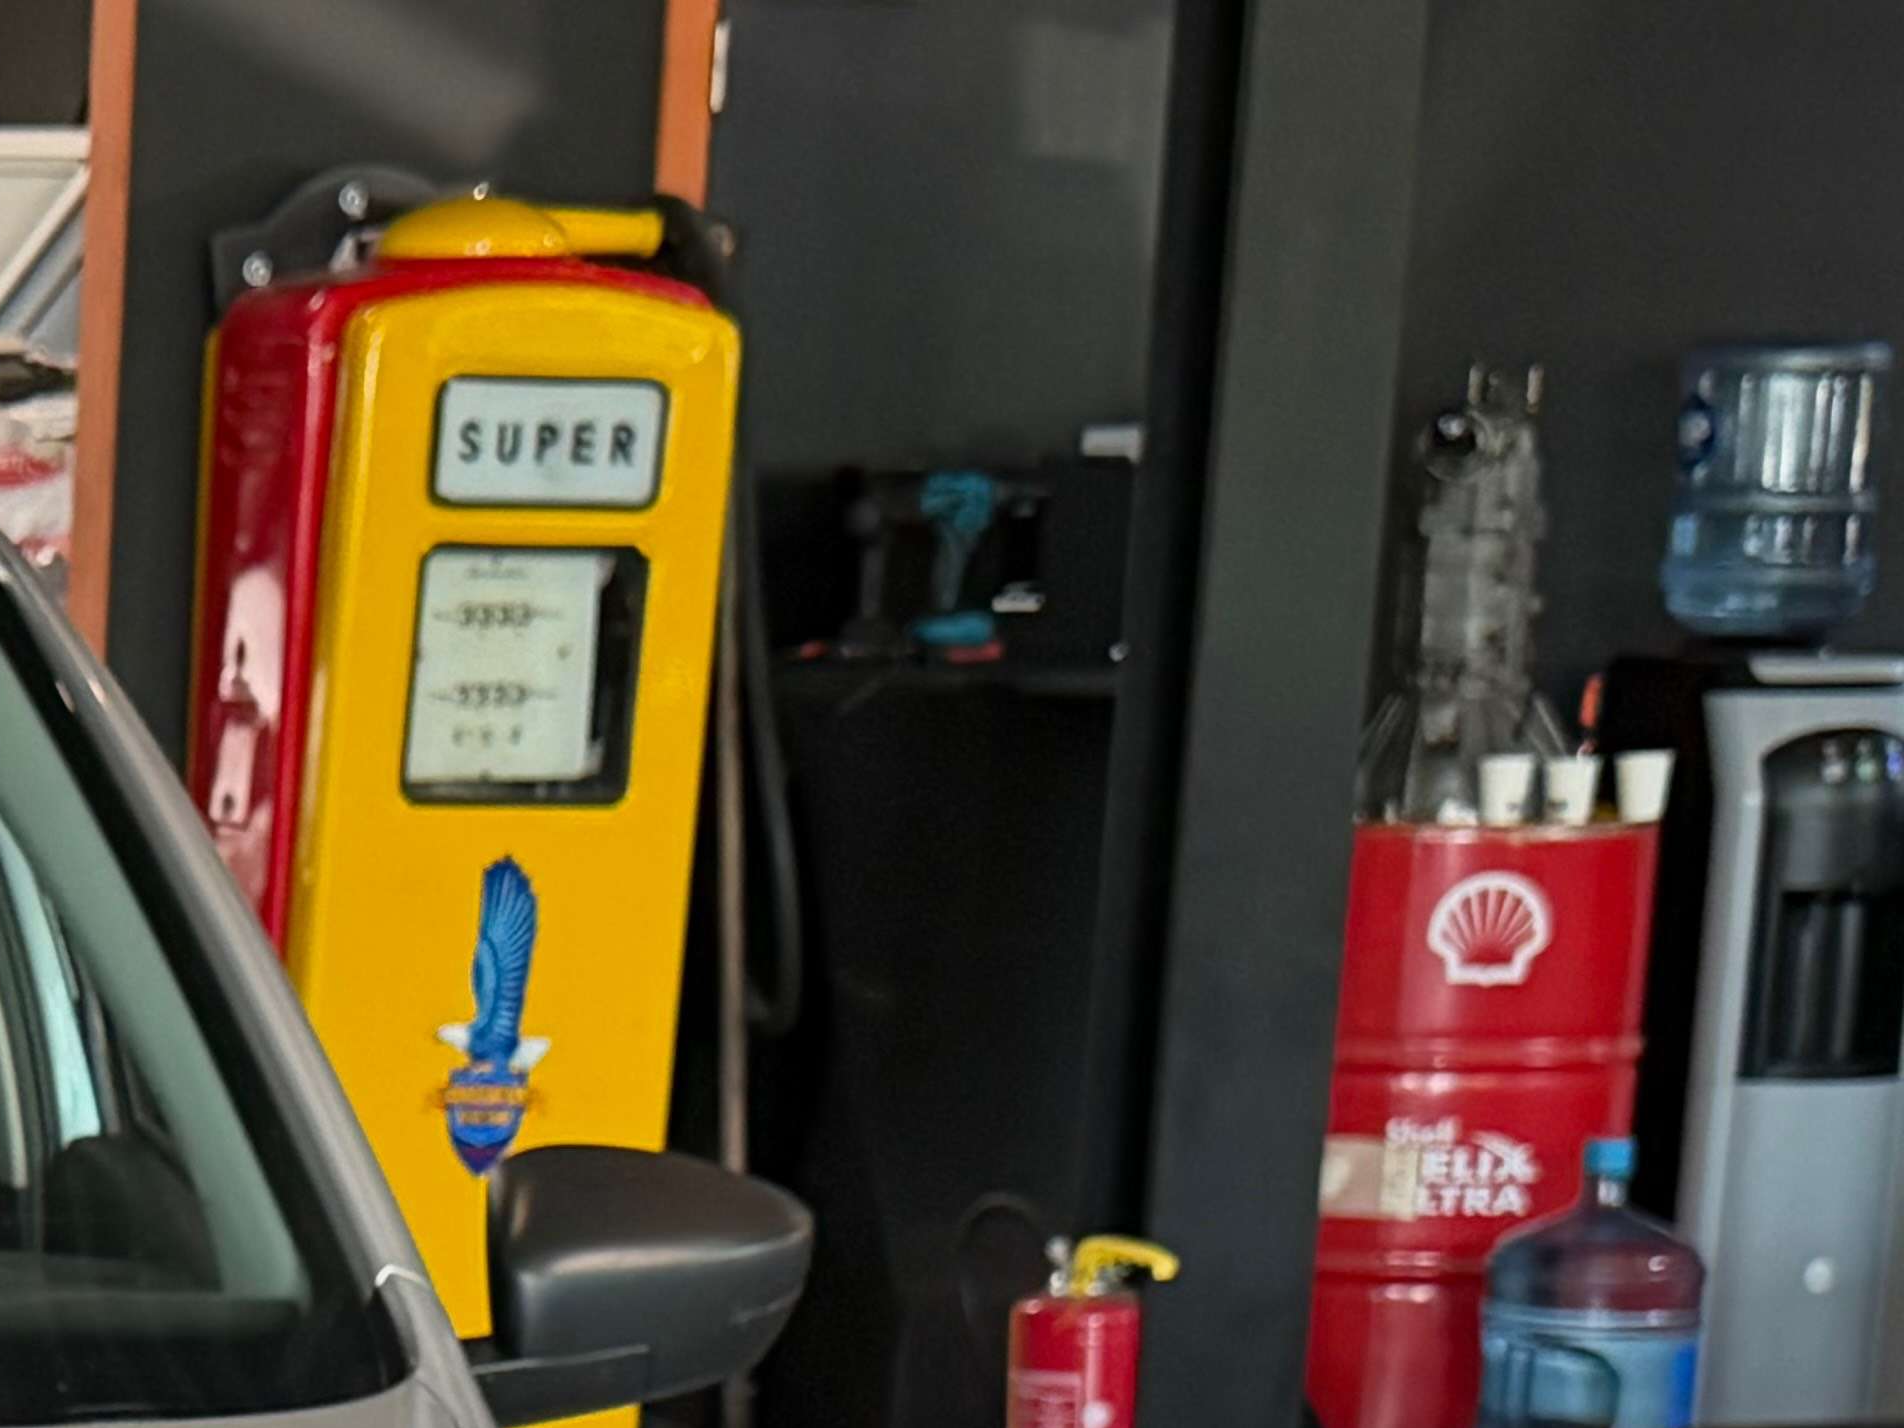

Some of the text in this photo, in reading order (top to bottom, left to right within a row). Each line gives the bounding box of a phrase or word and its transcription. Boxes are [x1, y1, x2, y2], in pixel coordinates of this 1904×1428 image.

[458, 419, 637, 467] SUPER
[1420, 1140, 1536, 1184] ELIX
[1413, 1185, 1530, 1217] LTRA
